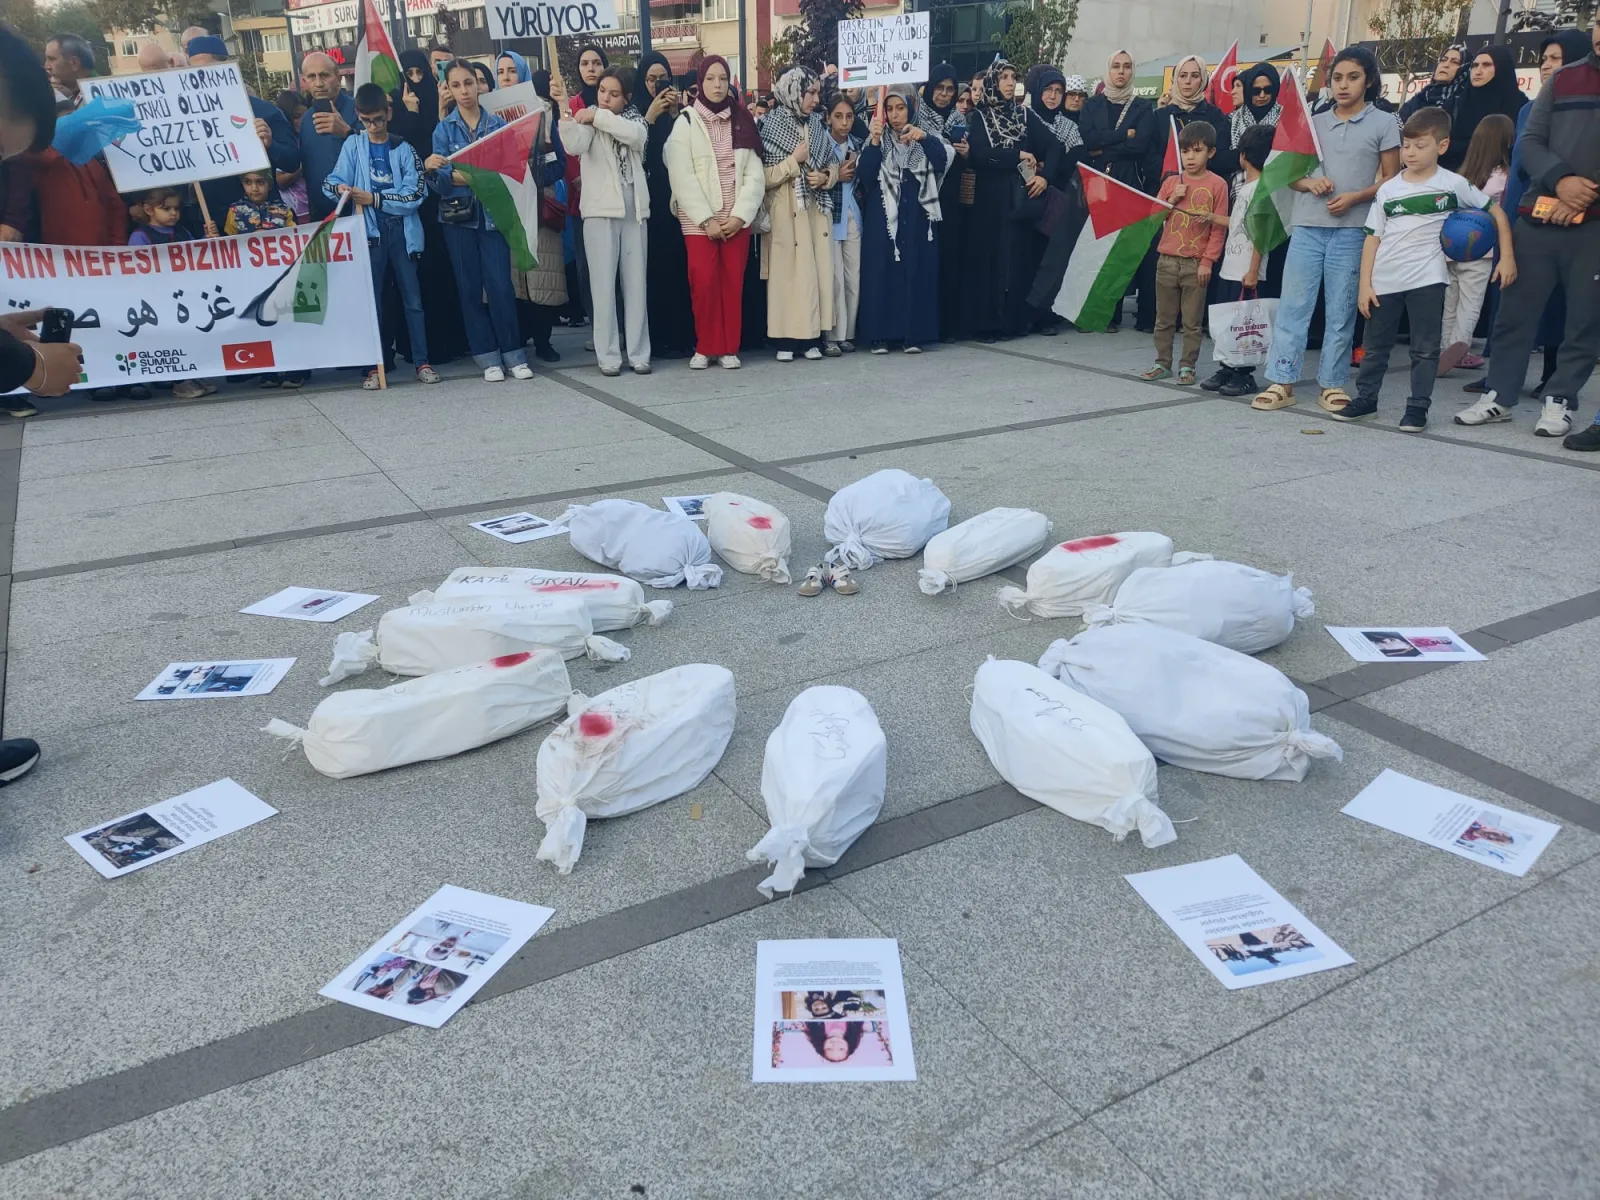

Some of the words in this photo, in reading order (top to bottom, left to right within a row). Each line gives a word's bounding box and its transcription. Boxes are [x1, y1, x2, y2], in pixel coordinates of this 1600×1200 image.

[883, 28, 895, 42] EY
[847, 55, 857, 65] EN
[875, 62, 895, 75] SEN
[901, 61, 917, 72] OL
[90, 76, 166, 100] ÖLÜMDEN
[178, 68, 239, 92] KORKMA
[178, 92, 224, 116] ÖLÜM
[136, 117, 225, 148] GAZZE'DE
[138, 148, 196, 176] ÇOCUK
[206, 140, 240, 167] İŞİ!
[118, 299, 158, 337] هو
[172, 285, 235, 333] غزة
[138, 349, 187, 359] GLOBAL
[140, 356, 180, 367] SUMUD
[141, 363, 198, 375] FLOTILLA
